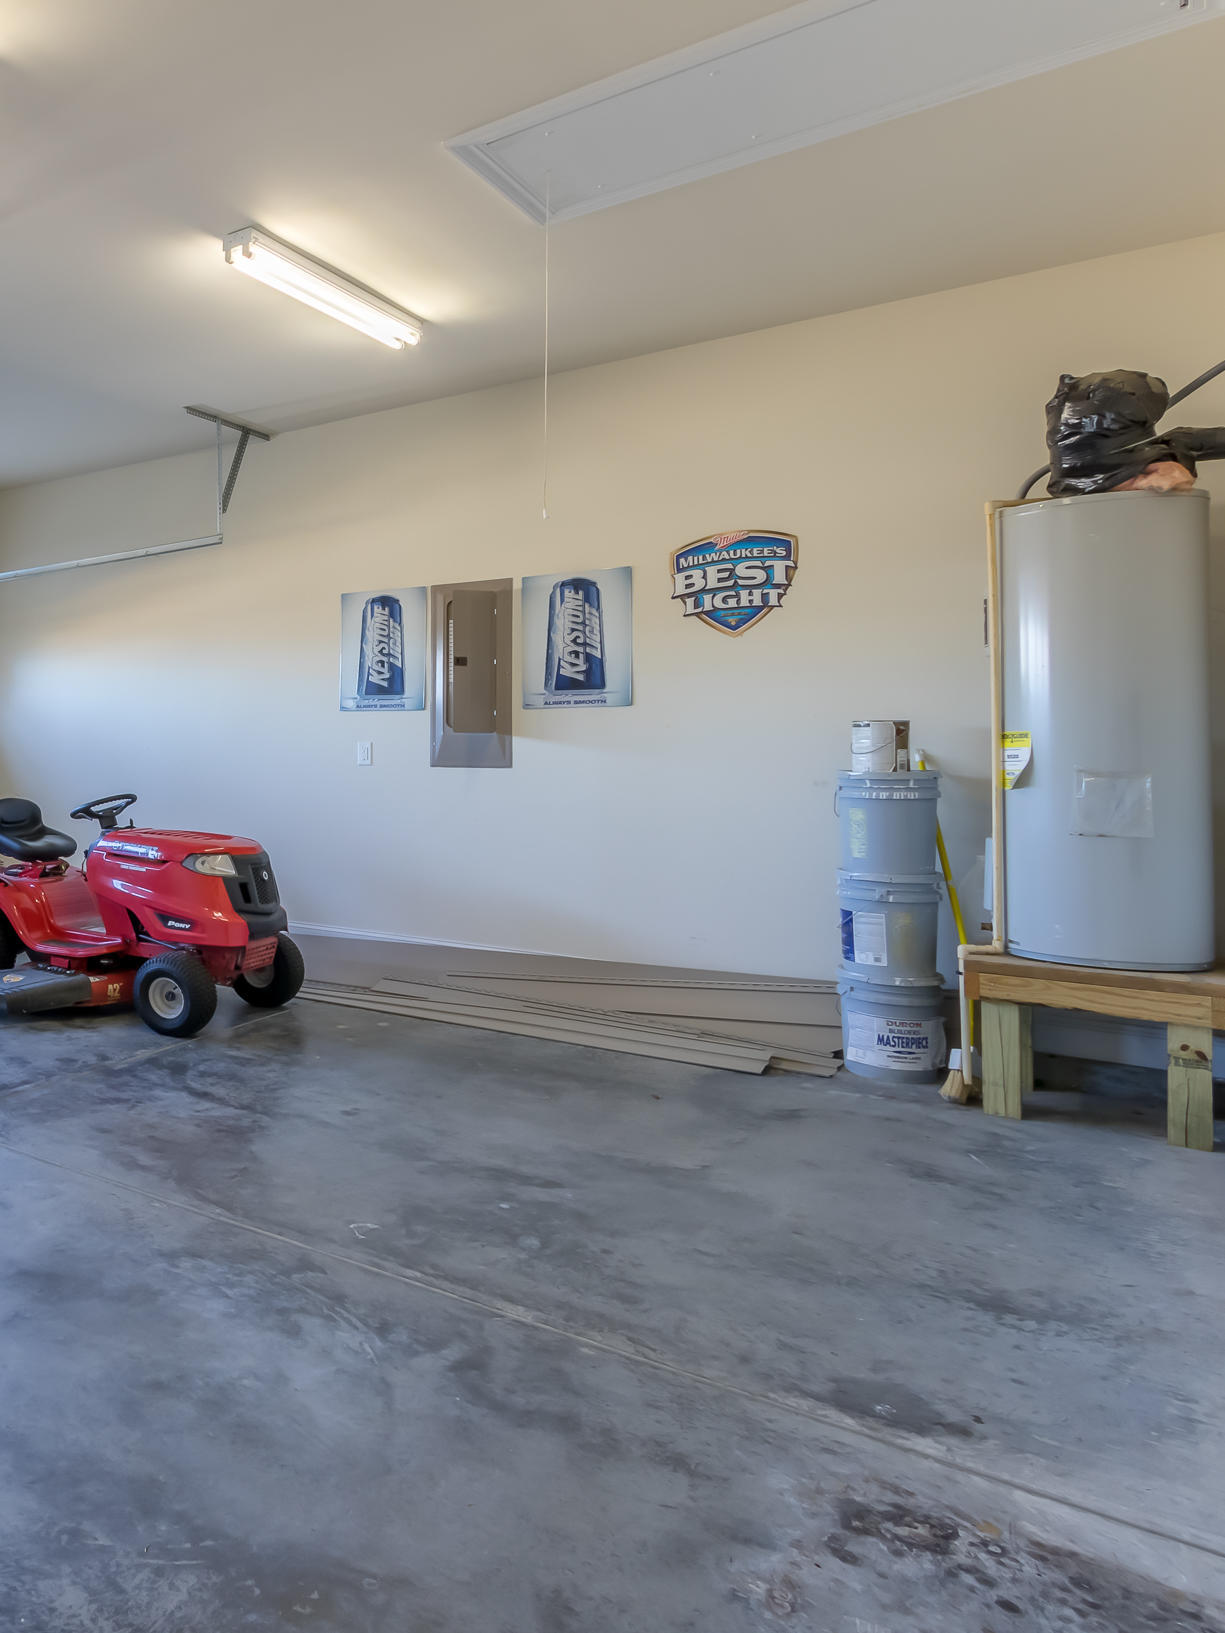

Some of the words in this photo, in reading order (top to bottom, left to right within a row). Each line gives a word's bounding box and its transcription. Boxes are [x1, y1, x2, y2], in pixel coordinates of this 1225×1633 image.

[679, 546, 787, 569] MILWAUKEE'S
[672, 560, 796, 599] BEST
[683, 588, 786, 617] LIGHT
[368, 604, 391, 688] KEYSTONE
[559, 587, 587, 682] KEYSTONE
[573, 698, 608, 706] SMOOTH
[167, 920, 191, 929] PONY
[877, 1033, 929, 1049] MASTERPIECE
